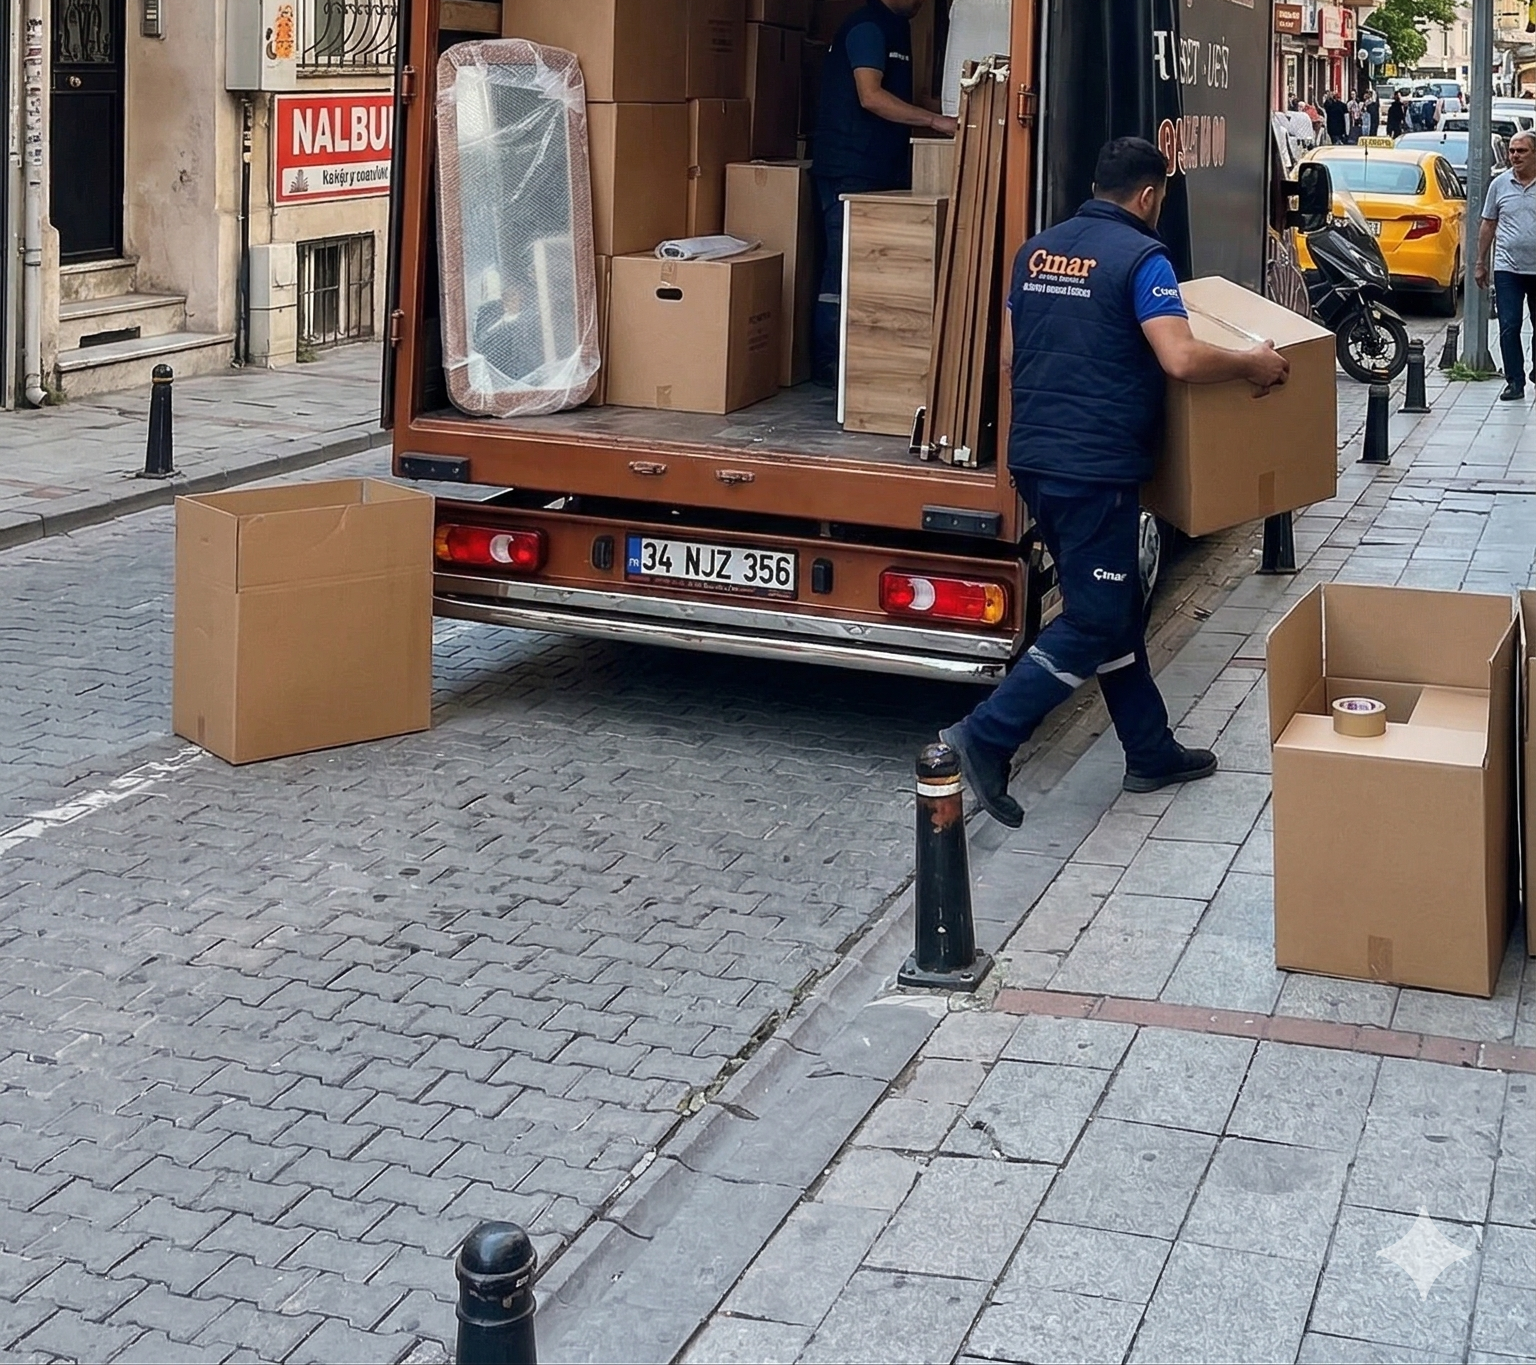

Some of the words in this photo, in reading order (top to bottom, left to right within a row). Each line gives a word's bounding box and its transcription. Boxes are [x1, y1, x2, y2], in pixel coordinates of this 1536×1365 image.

[292, 105, 394, 155] NALBU
[642, 542, 673, 574] 34
[685, 545, 732, 580] NJZ
[743, 552, 791, 586] 356
